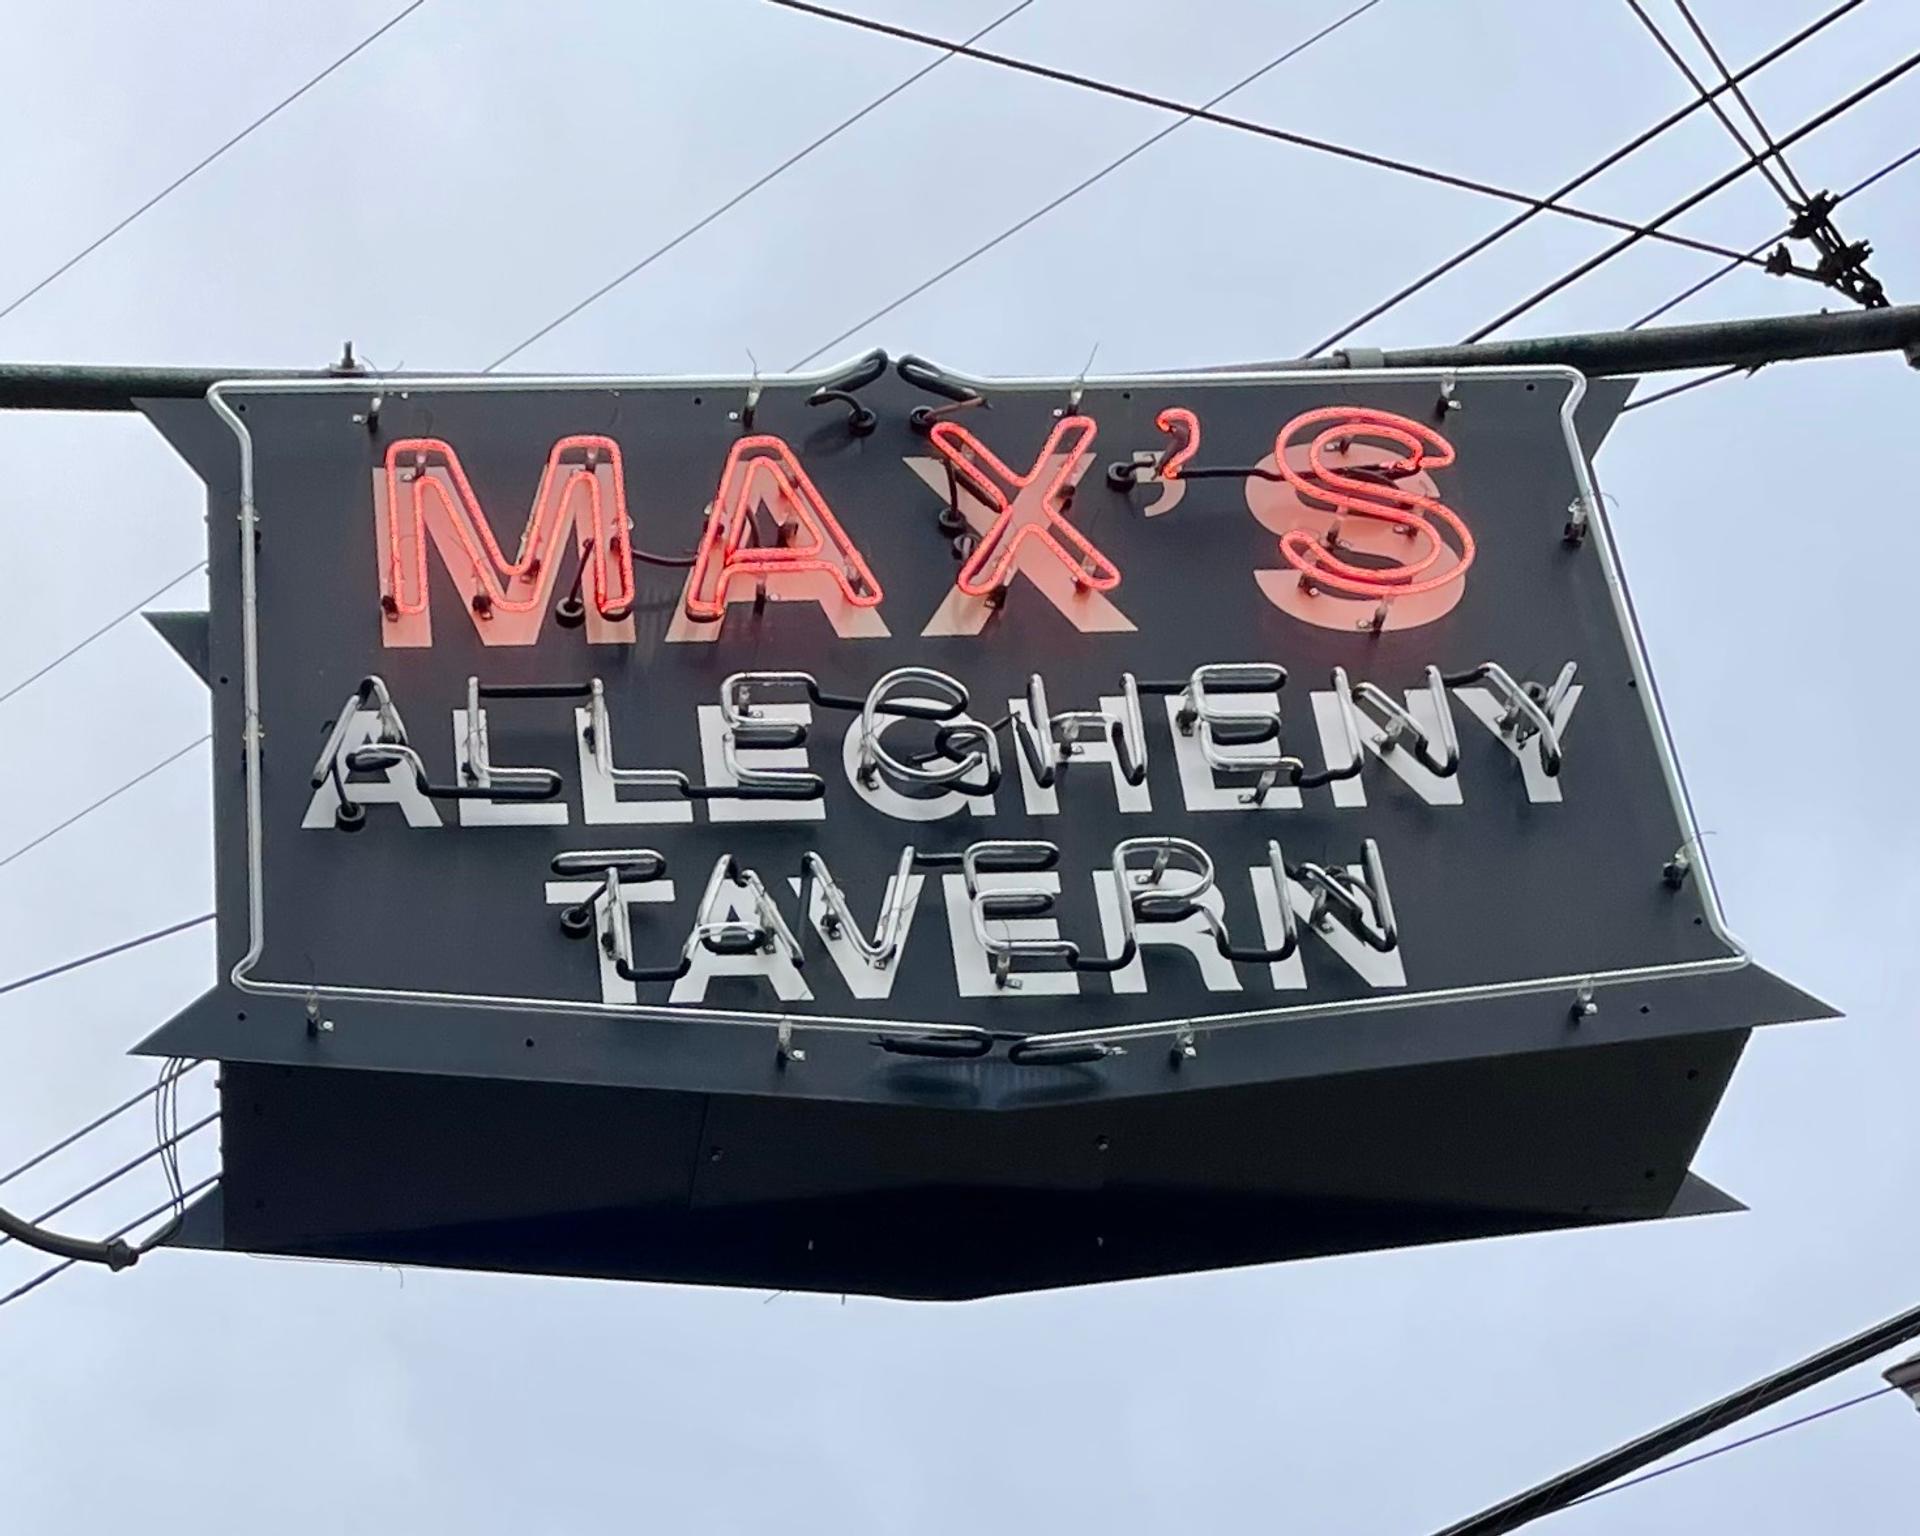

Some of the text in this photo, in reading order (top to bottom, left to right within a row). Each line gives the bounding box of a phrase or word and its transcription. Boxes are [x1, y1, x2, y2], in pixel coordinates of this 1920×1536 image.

[372, 406, 1476, 648] MAX'S
[301, 662, 1584, 830] ALLEGHENY
[545, 837, 1408, 1005] TAVERN
